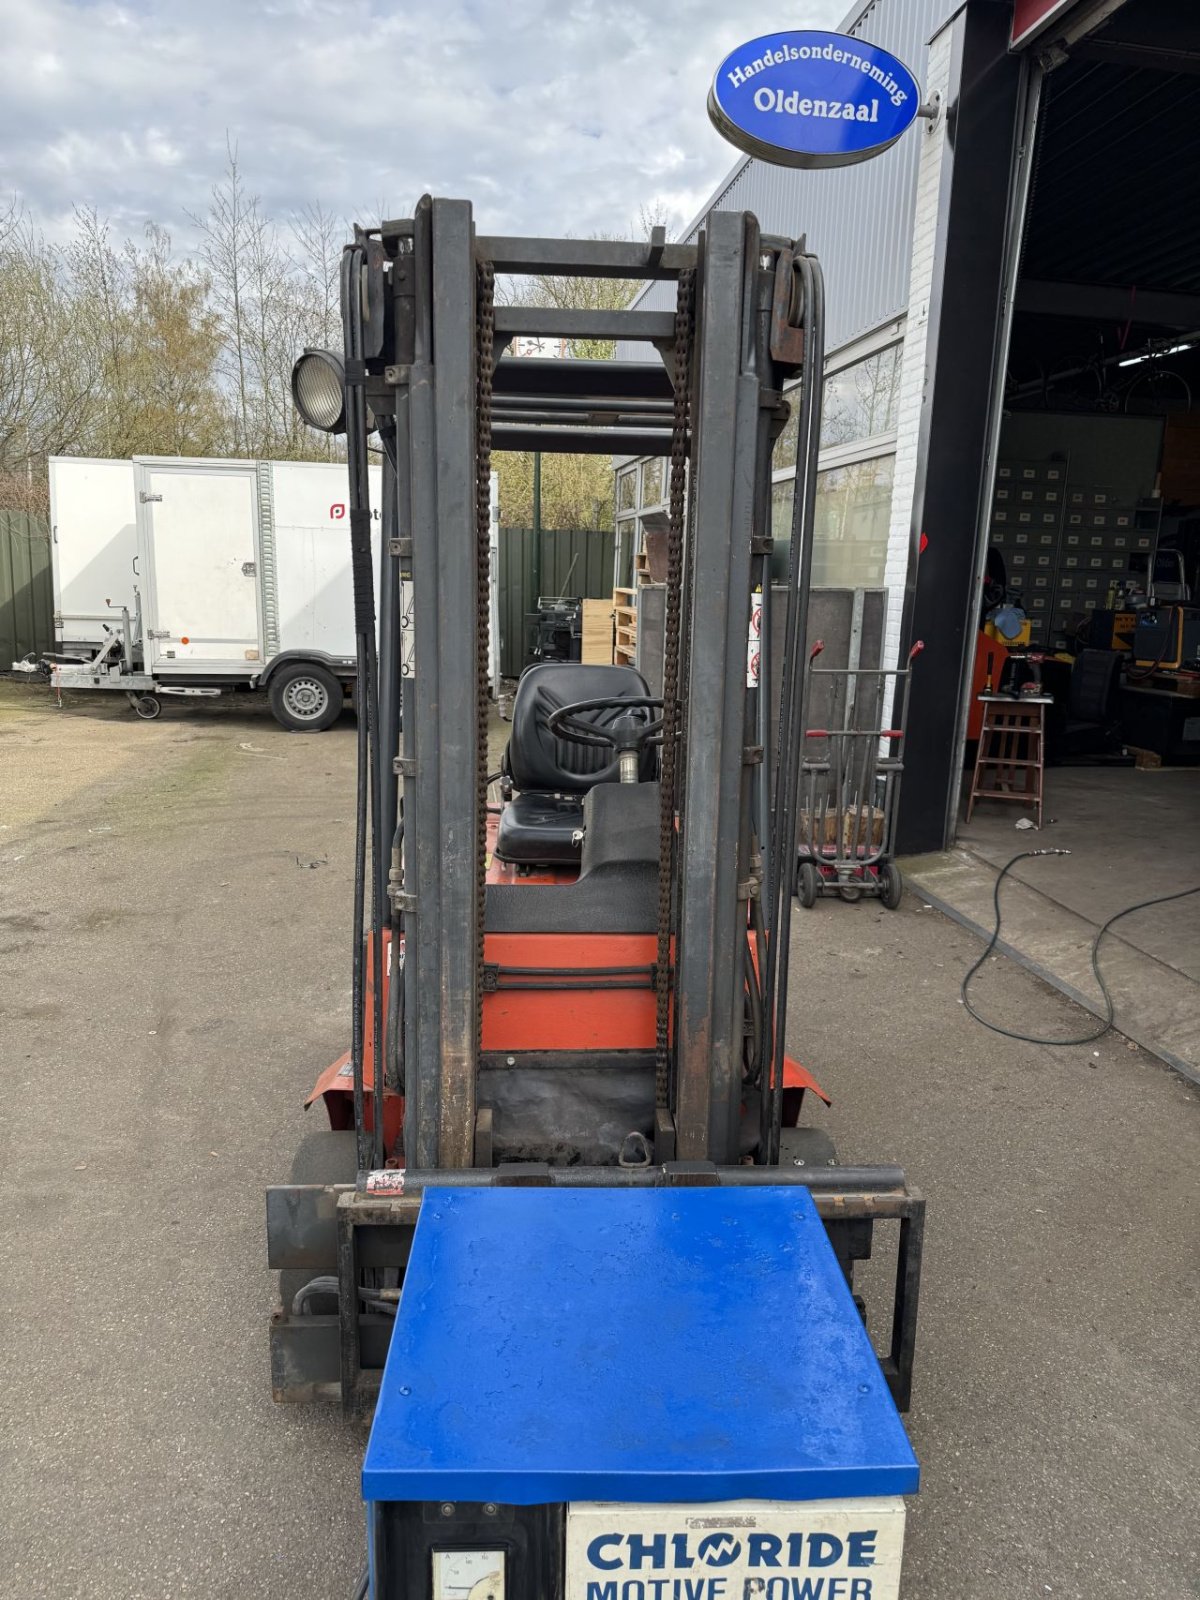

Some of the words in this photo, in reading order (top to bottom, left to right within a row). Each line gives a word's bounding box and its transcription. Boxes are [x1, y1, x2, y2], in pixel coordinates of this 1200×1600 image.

[727, 44, 908, 107] Handelsonderneming
[754, 87, 879, 123] Oldenzaal
[587, 1530, 878, 1571] CHLORIDE
[587, 1577, 727, 1600] MOTIVE
[743, 1576, 872, 1600] POWER
